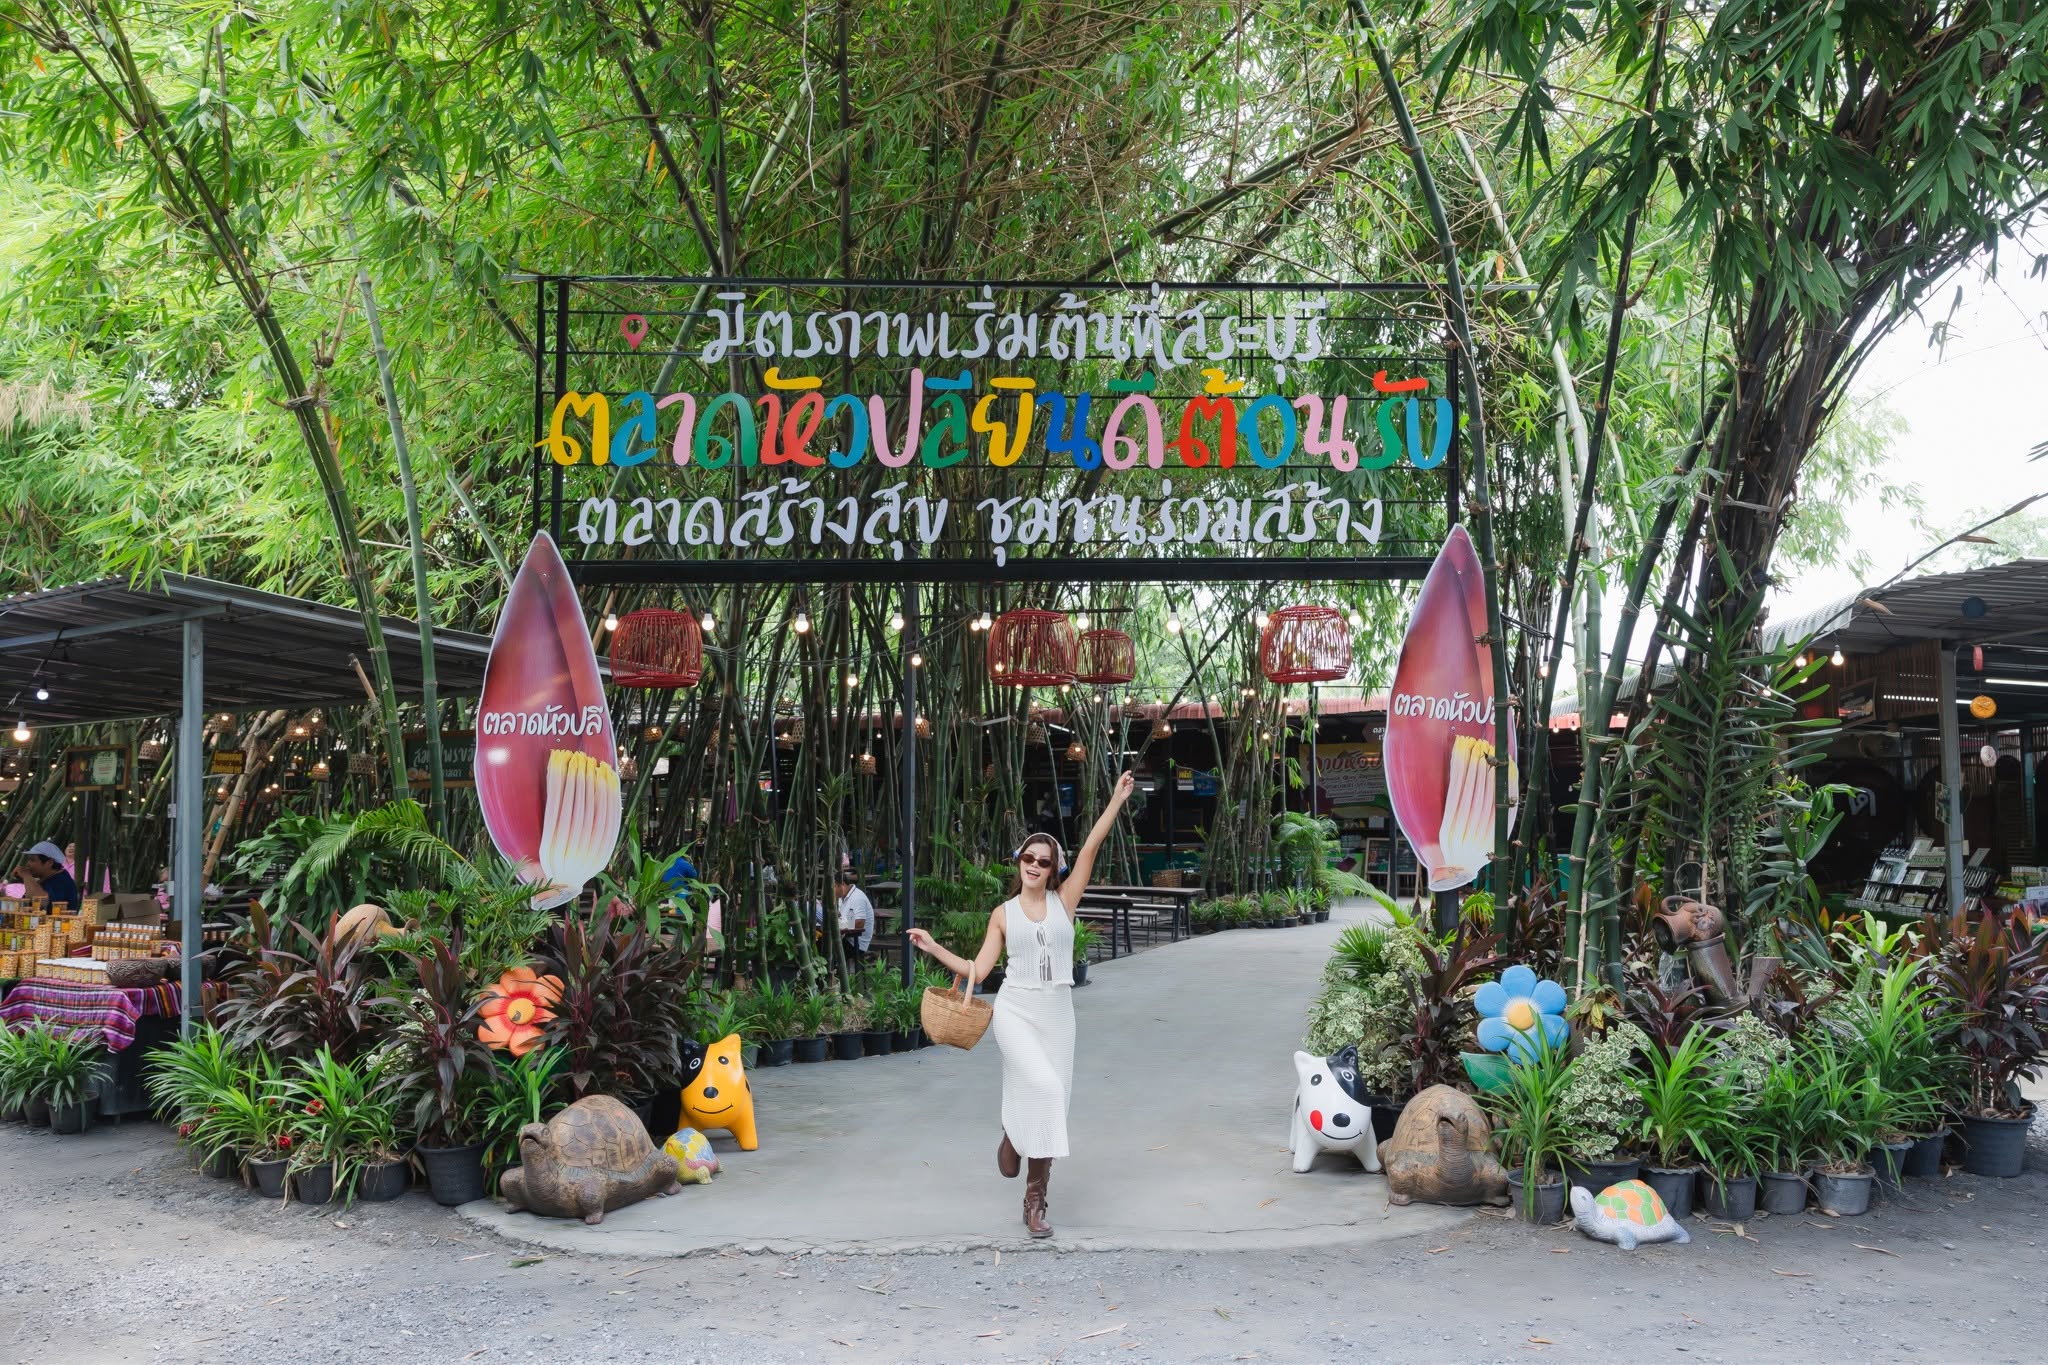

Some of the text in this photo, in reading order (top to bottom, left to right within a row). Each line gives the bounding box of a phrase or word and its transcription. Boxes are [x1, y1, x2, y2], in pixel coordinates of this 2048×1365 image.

[705, 282, 1326, 385] มิตรภาพเริ่มต้นที่สระบุรี
[536, 367, 1453, 470] ตลาดหัวปลียินดีต้อนรับ
[569, 477, 1383, 567] ตลาดสร้างสุข ชุมชนร่วมสร้าง
[483, 704, 604, 736] ตลาดหัวปลี
[1394, 691, 1496, 725] ตลาดหัวป
